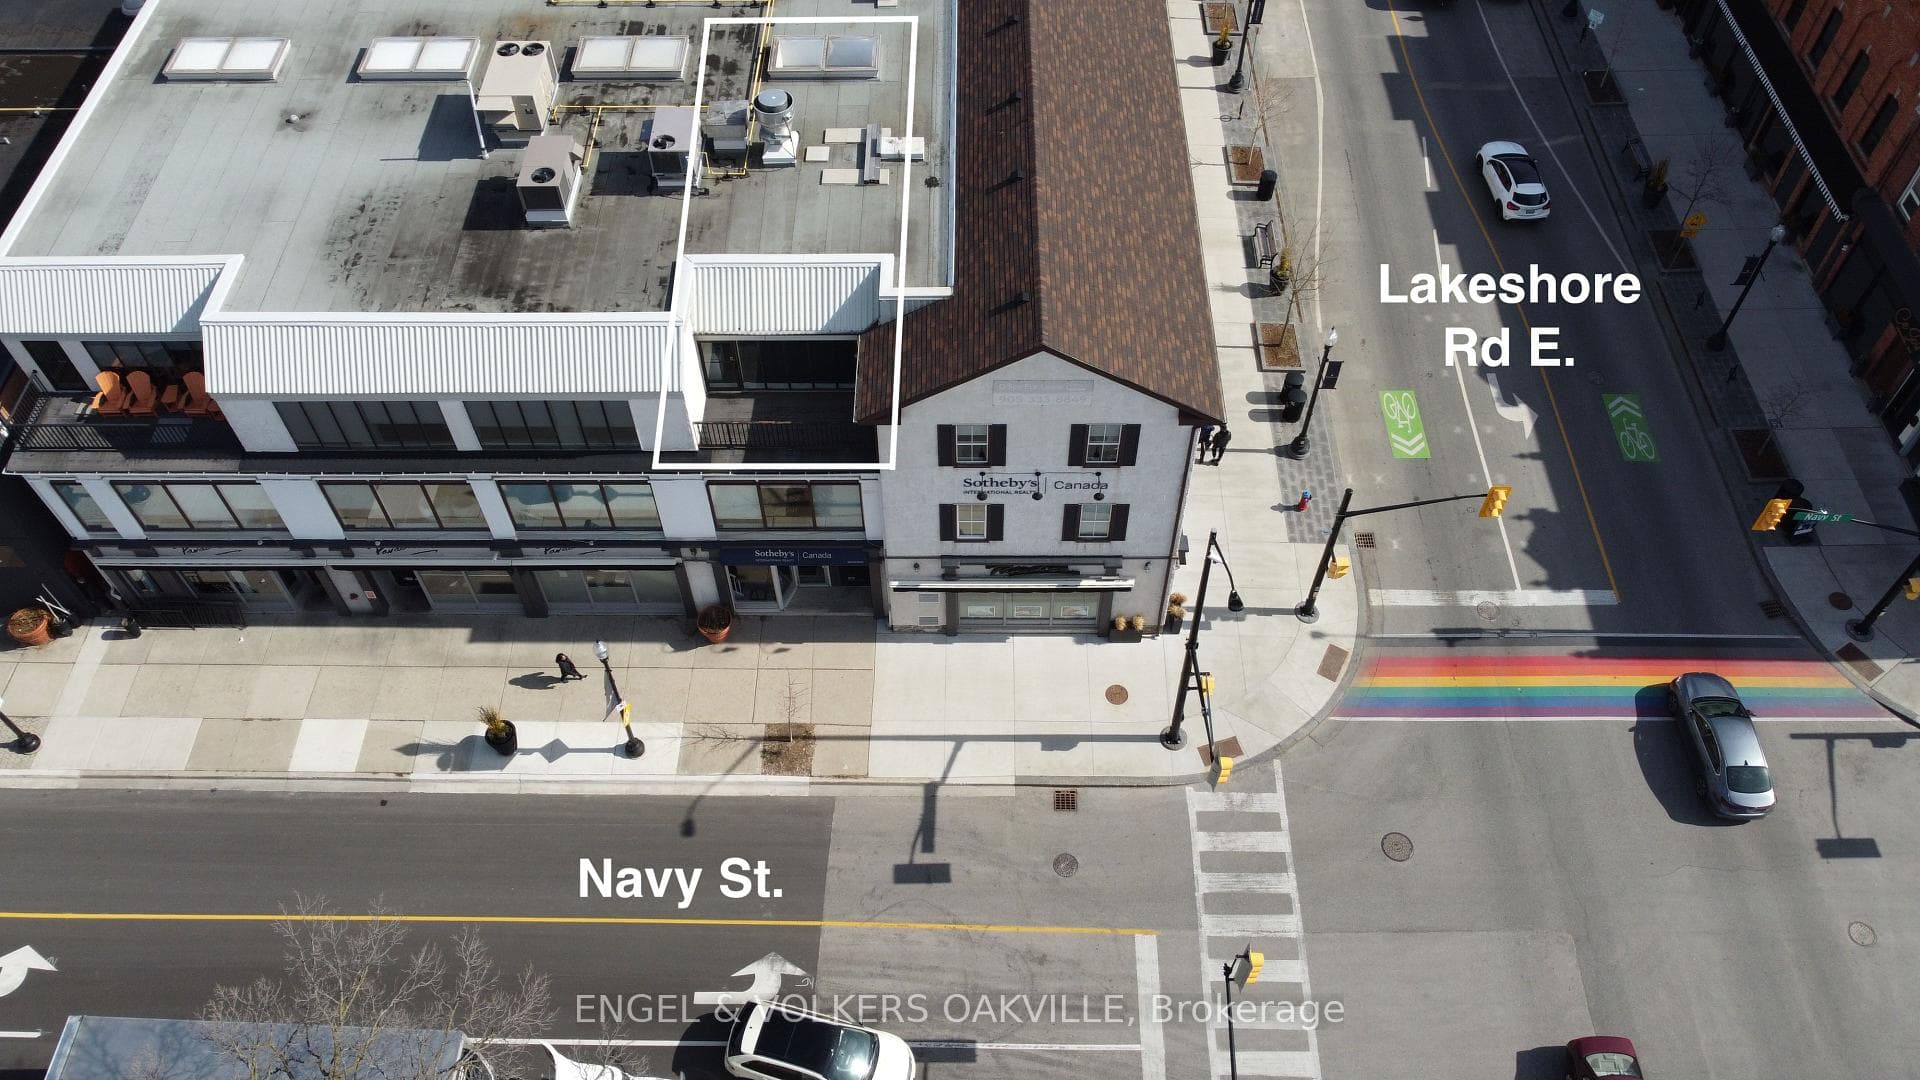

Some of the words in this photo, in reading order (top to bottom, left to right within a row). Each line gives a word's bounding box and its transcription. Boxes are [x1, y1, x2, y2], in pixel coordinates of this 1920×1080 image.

[963, 477, 1038, 490] Sotheby's
[1054, 480, 1109, 490] Canada
[1804, 512, 1829, 520] Navy
[1831, 514, 1842, 522] St
[754, 549, 794, 558] Sotheby's
[802, 551, 832, 559] Canada
